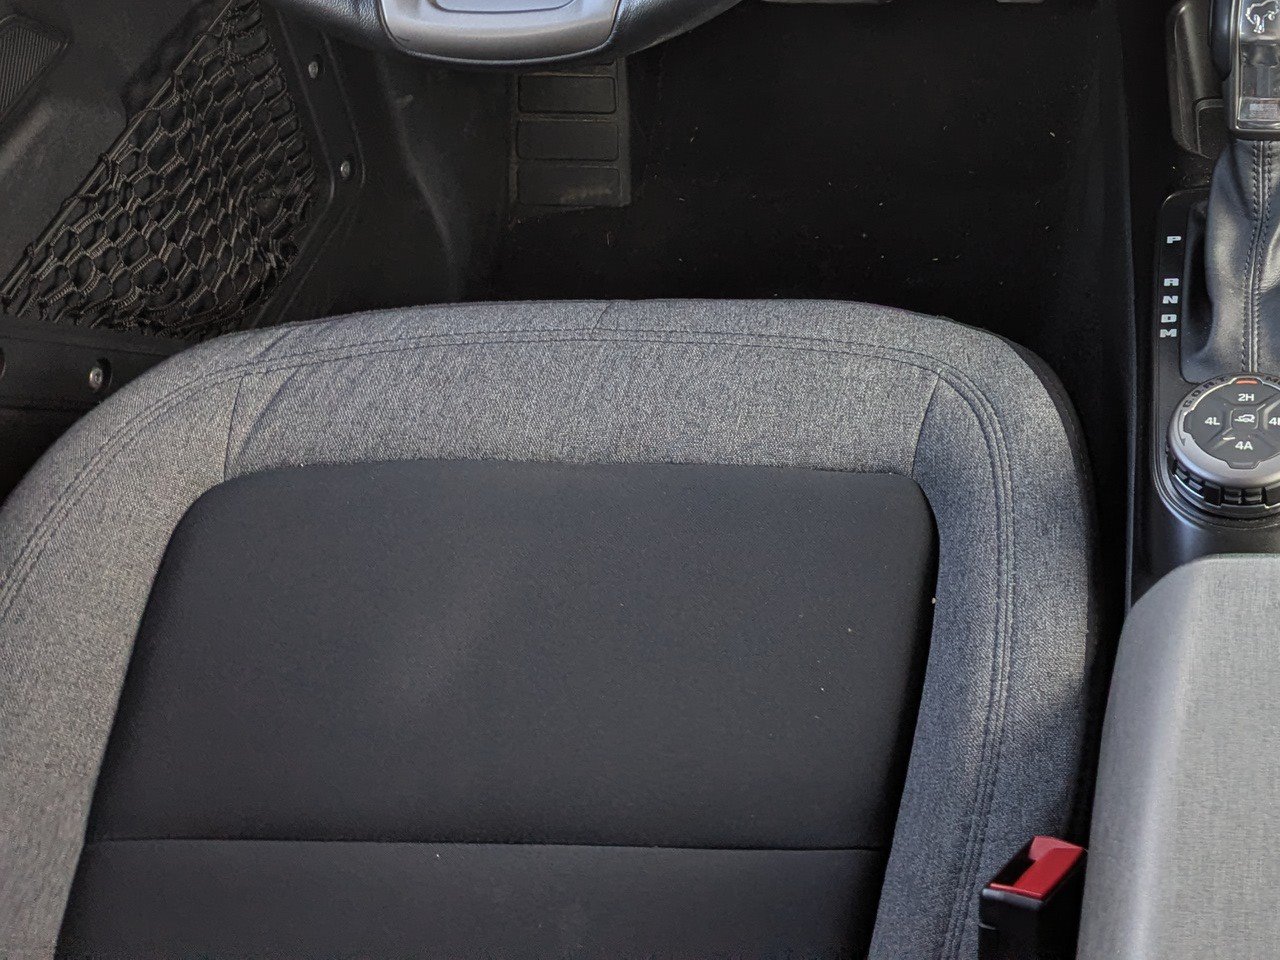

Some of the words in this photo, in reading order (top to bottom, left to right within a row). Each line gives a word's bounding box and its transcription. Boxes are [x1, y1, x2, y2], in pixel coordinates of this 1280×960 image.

[1166, 235, 1182, 244] P
[1162, 295, 1178, 304] N
[1161, 314, 1177, 323] D
[1160, 329, 1177, 337] M
[1237, 393, 1255, 402] 2H
[1204, 417, 1221, 426] 4L
[1235, 441, 1254, 451] 4A
